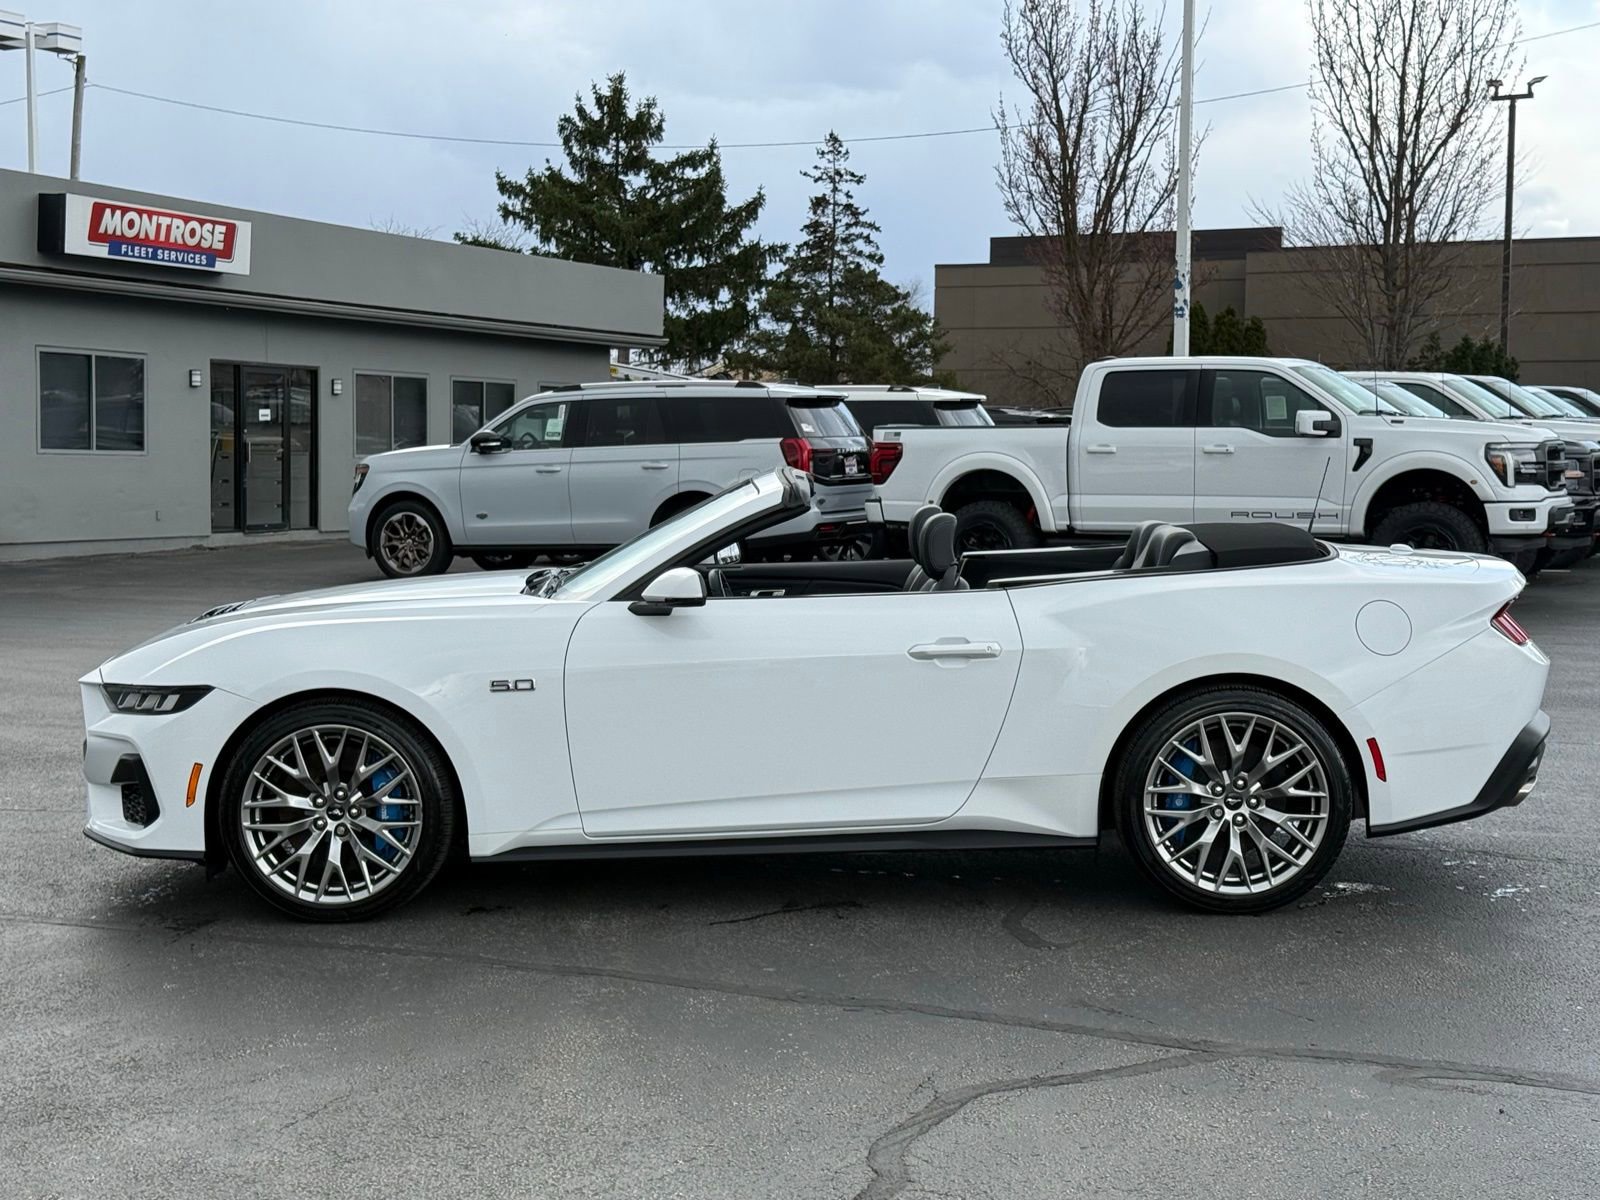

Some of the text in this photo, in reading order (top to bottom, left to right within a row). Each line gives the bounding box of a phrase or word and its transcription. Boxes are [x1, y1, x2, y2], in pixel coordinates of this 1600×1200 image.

[98, 208, 227, 250] MONTROSE
[121, 244, 207, 265] FLEET SERVICES
[1230, 511, 1339, 519] ROUSH
